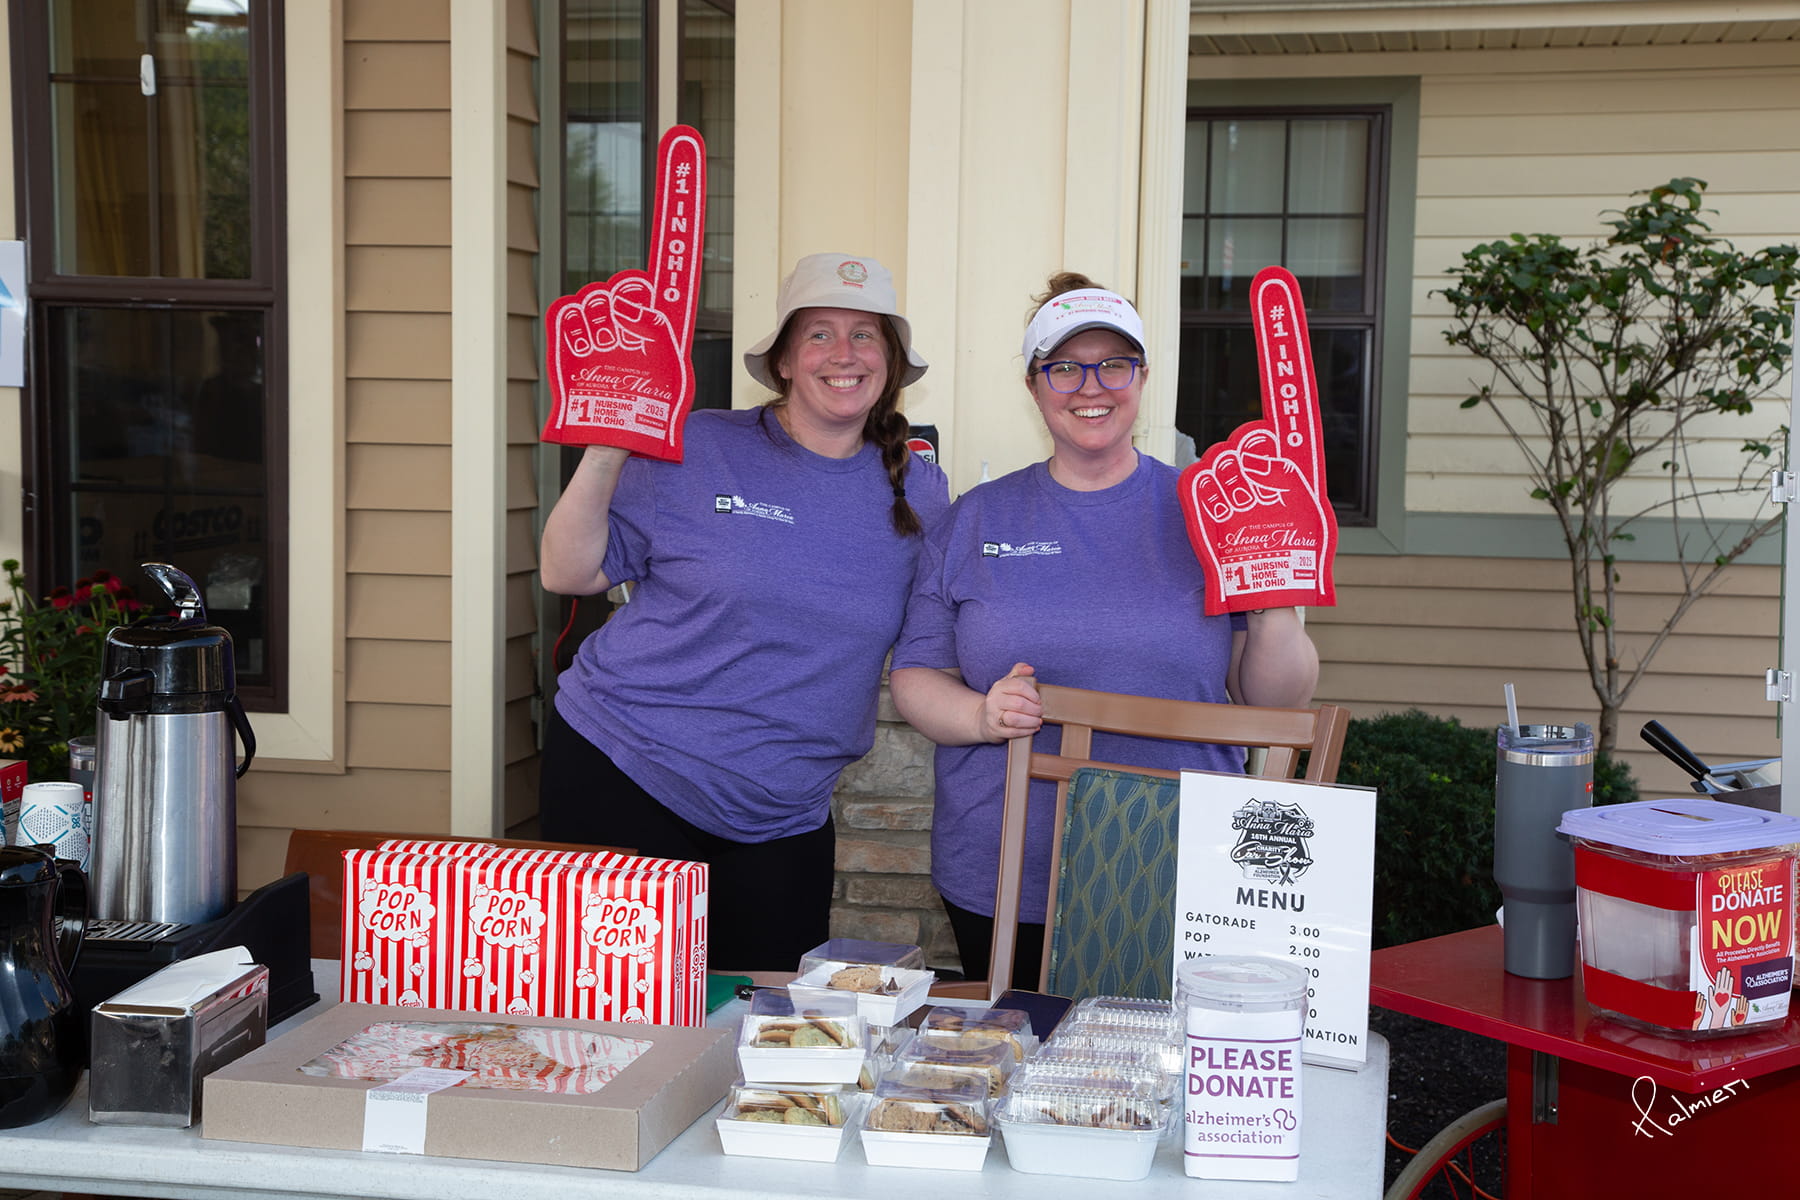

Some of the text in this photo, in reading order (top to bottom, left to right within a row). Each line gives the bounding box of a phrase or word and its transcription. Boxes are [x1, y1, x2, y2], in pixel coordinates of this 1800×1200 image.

[663, 162, 691, 302] #1 IN OHIO
[570, 365, 672, 400] Anna Maria
[1270, 304, 1303, 447] #1 IN OHIO
[571, 398, 633, 422] #1 NURSING
[593, 415, 625, 426] IN OHIO
[594, 408, 619, 417] HOME
[645, 403, 664, 417] 2025
[1217, 526, 1317, 548] Anna Maria
[1225, 560, 1290, 591] #1 NURSING
[1251, 570, 1278, 580] HOME
[1252, 578, 1286, 589] IN OHIO
[1232, 815, 1313, 836] Anna Maria
[1268, 835, 1297, 844] ANNUAL
[1231, 841, 1313, 867] Car Show
[1718, 869, 1763, 895] PLEASE
[376, 889, 415, 911] POP
[487, 895, 526, 918] POP
[1236, 887, 1305, 912] MENU
[1712, 884, 1783, 912] DONATE
[369, 909, 421, 931] CORN
[600, 904, 640, 926] POP
[1185, 912, 1320, 938] GATORADE 3.00
[480, 916, 531, 938] CORN
[593, 924, 646, 948] CORN
[1712, 909, 1782, 950] NOW
[1185, 931, 1320, 958] POP 2.00
[1755, 975, 1789, 987] ASSOCIATION
[1305, 1028, 1358, 1045] NATION
[1191, 1046, 1293, 1071] PLEASE
[1189, 1073, 1294, 1098] DONATE
[1186, 1110, 1271, 1127] alzheimer's
[1198, 1130, 1282, 1144] association
